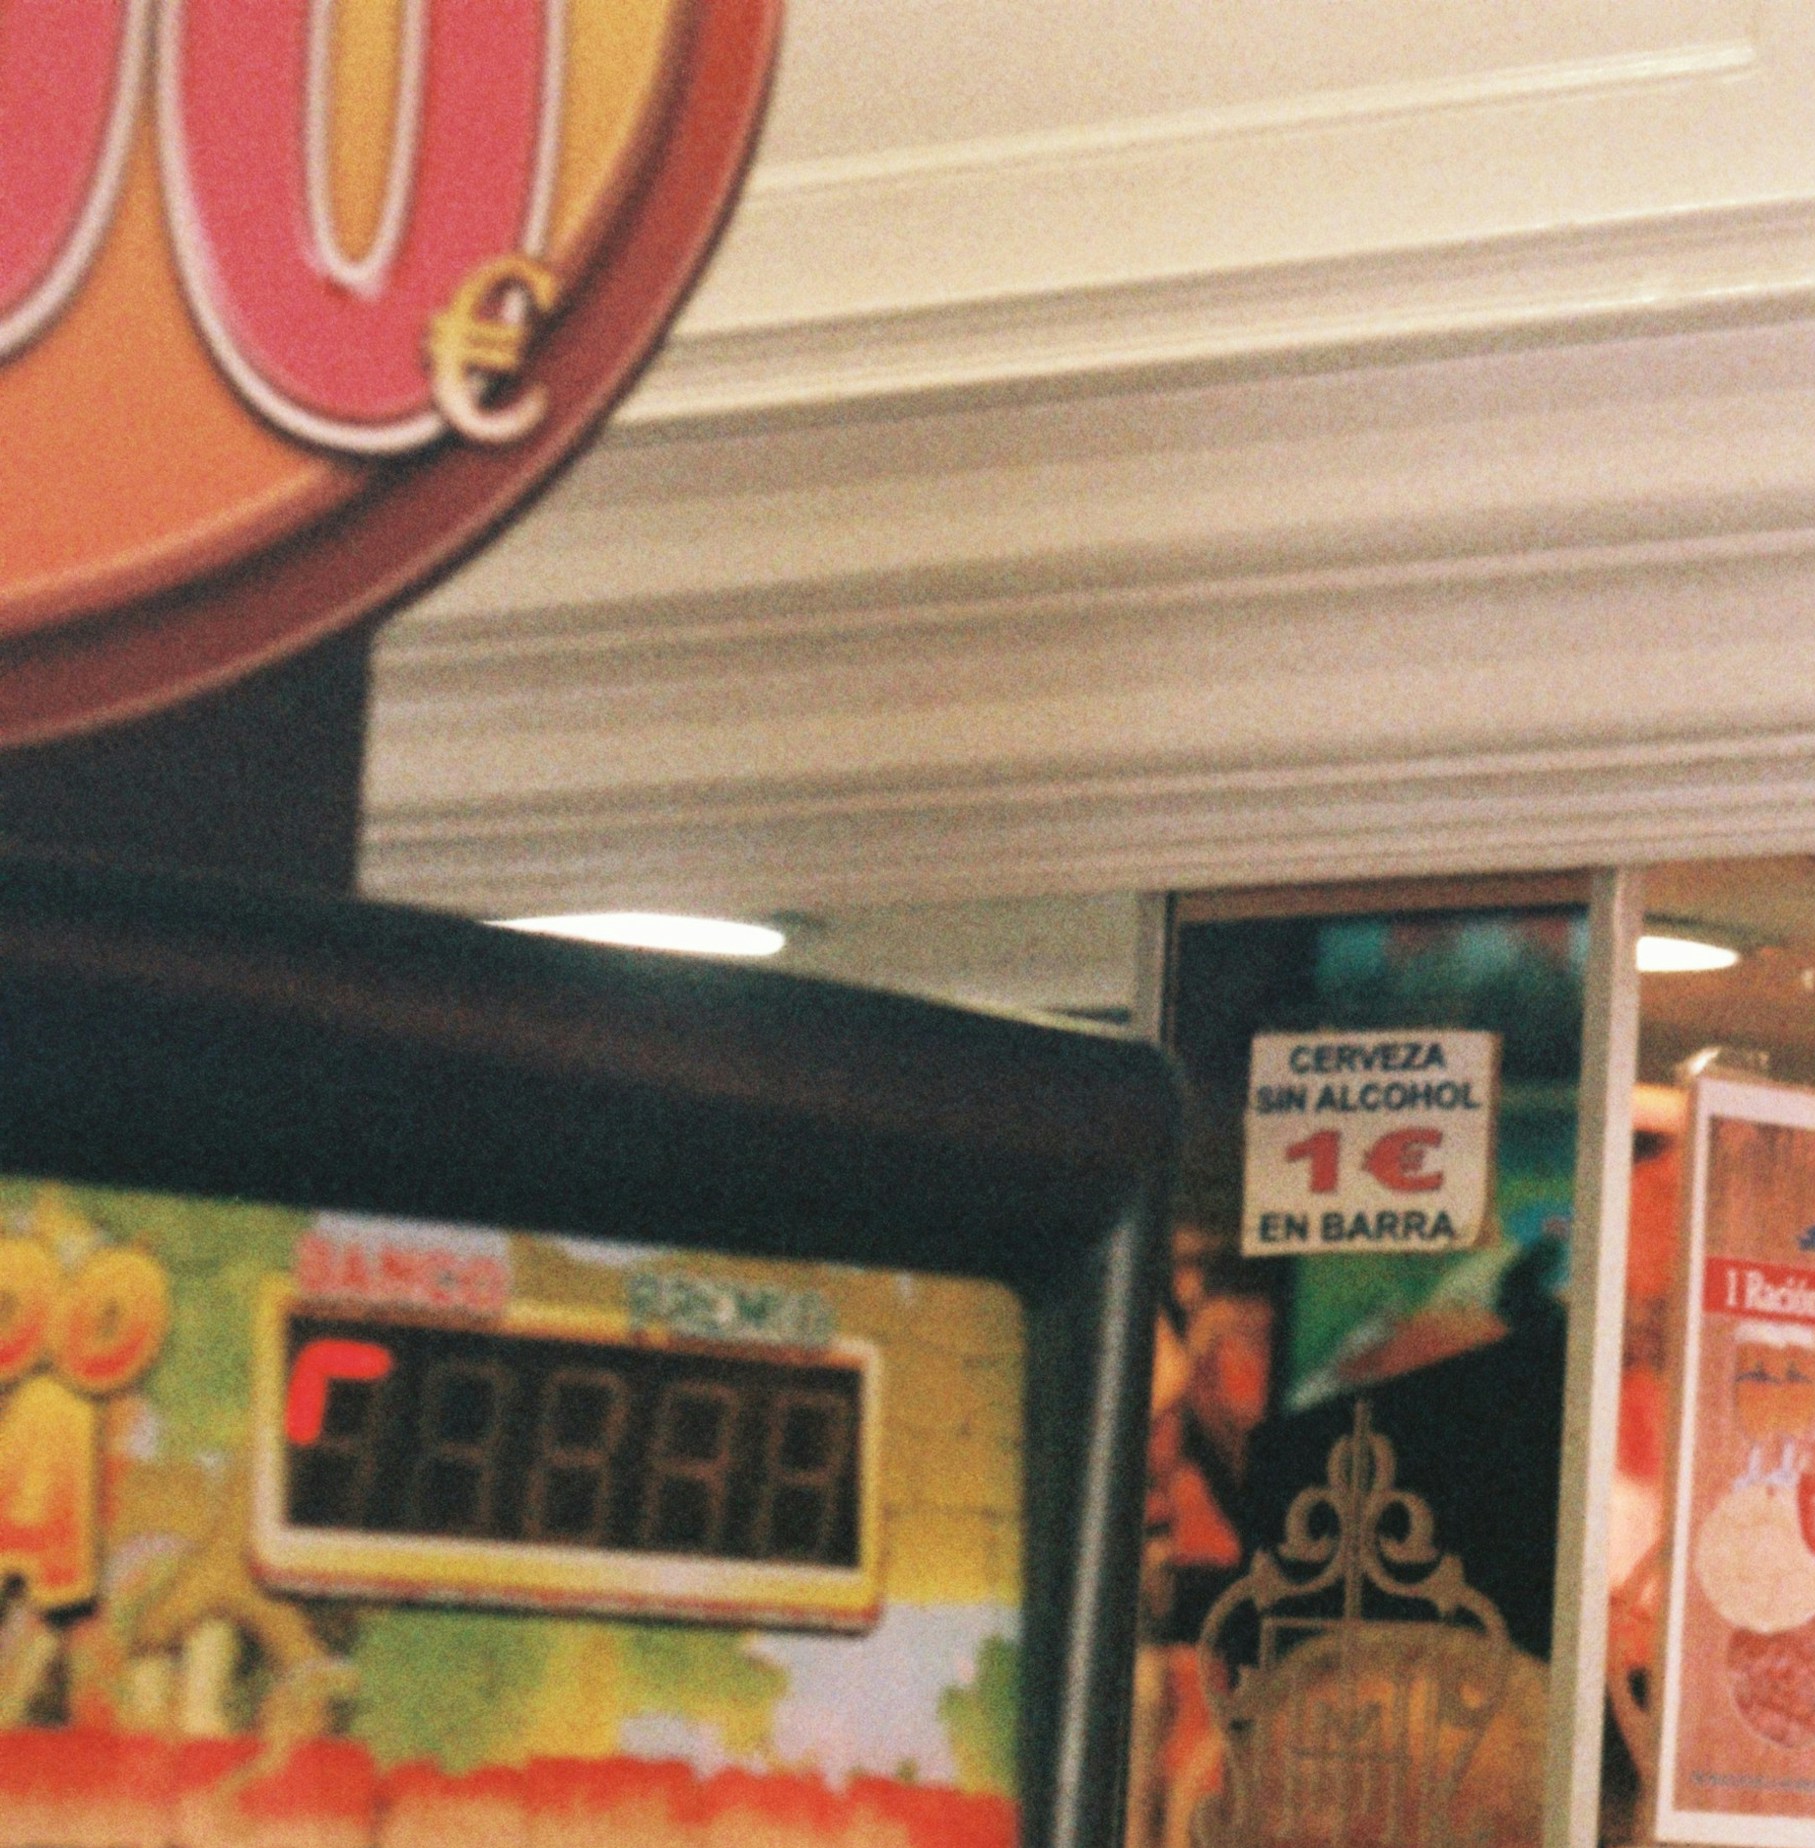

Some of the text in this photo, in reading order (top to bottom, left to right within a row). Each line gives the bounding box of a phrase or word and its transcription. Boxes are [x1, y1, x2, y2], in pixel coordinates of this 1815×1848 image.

[1289, 1042, 1447, 1074] CERVEZA
[1256, 1081, 1480, 1115] SIN ALCOHOL
[1285, 1126, 1444, 1195] 1€
[1259, 1210, 1455, 1242] EN BARRA
